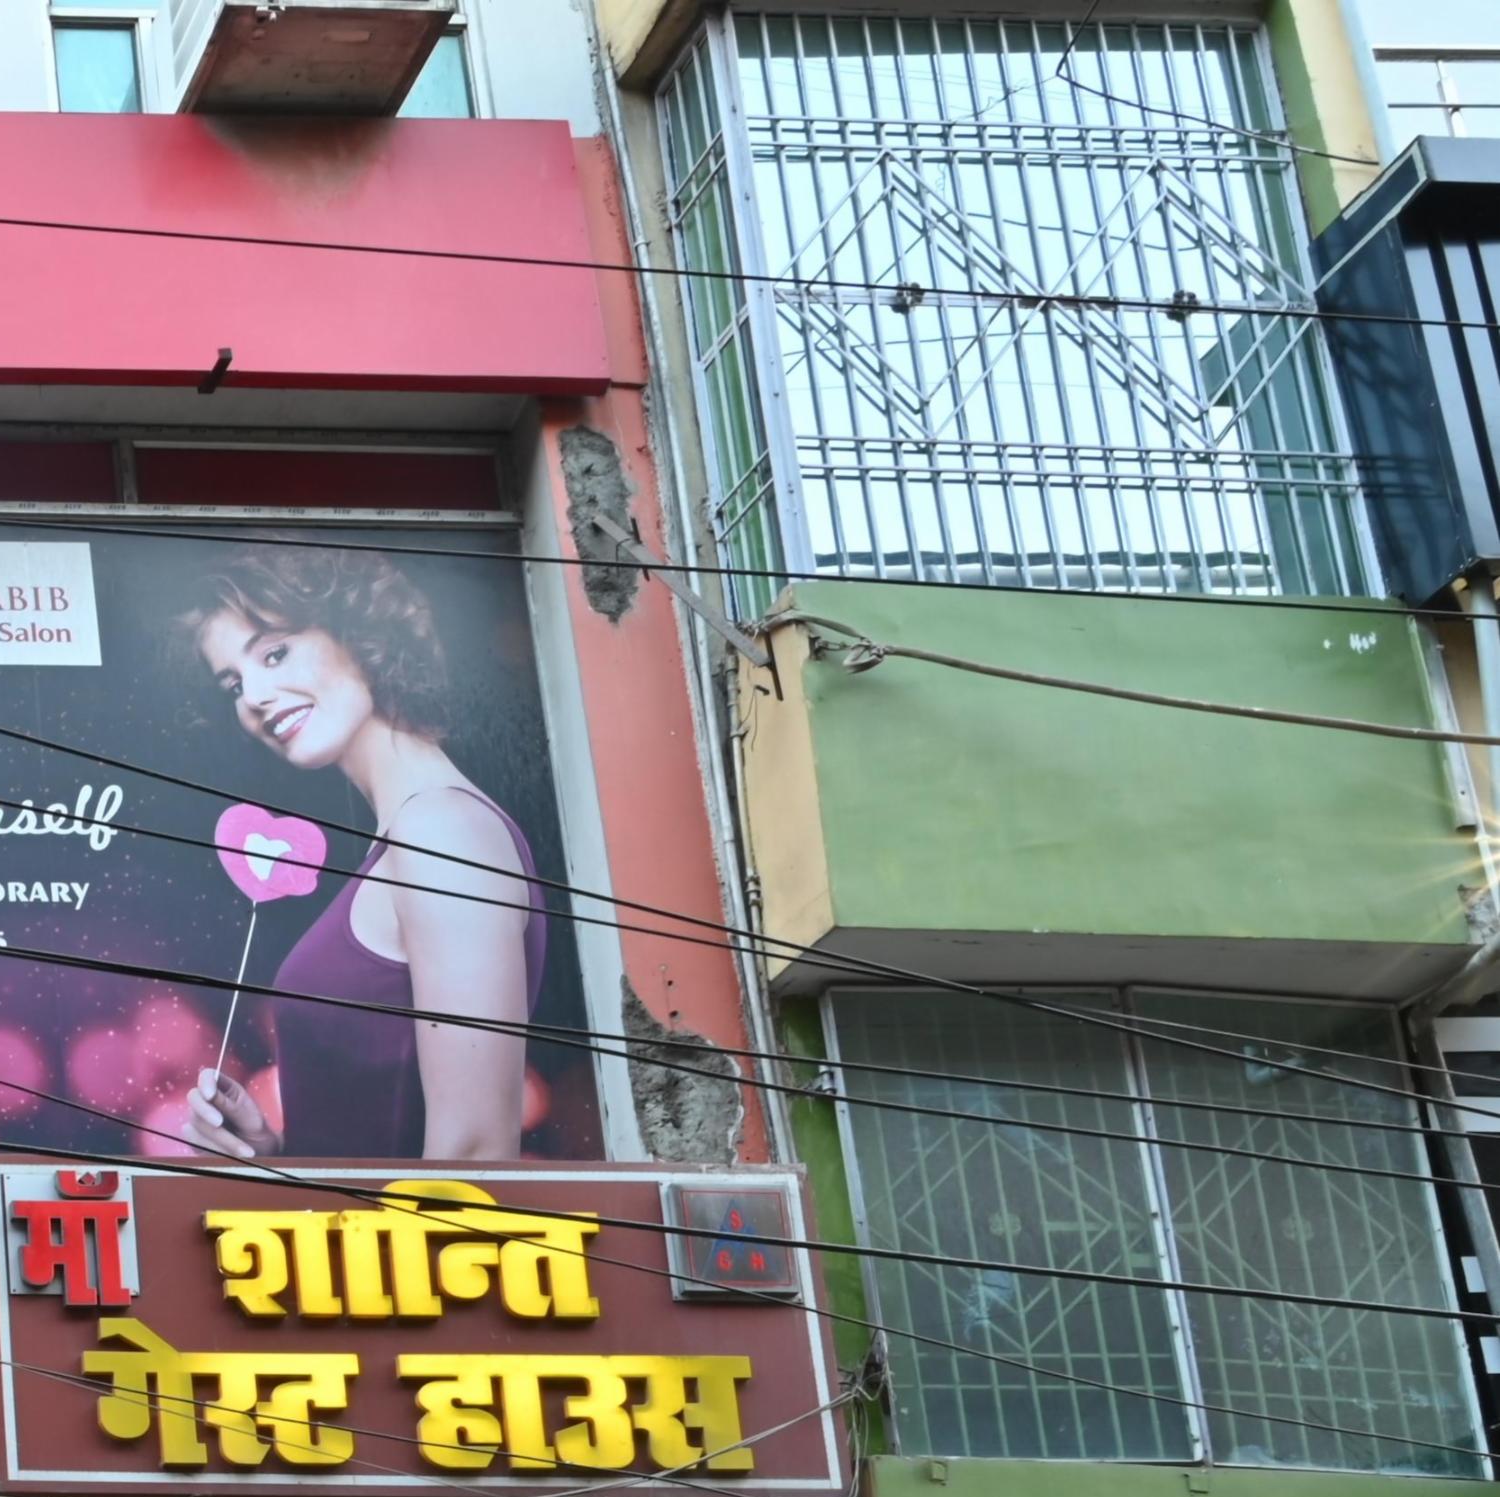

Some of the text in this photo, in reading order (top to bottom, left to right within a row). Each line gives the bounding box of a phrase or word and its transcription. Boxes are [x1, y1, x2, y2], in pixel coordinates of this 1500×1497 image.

[203, 1178, 600, 1321] शान्ति
[81, 1316, 755, 1472] गेस्ट हाउस
